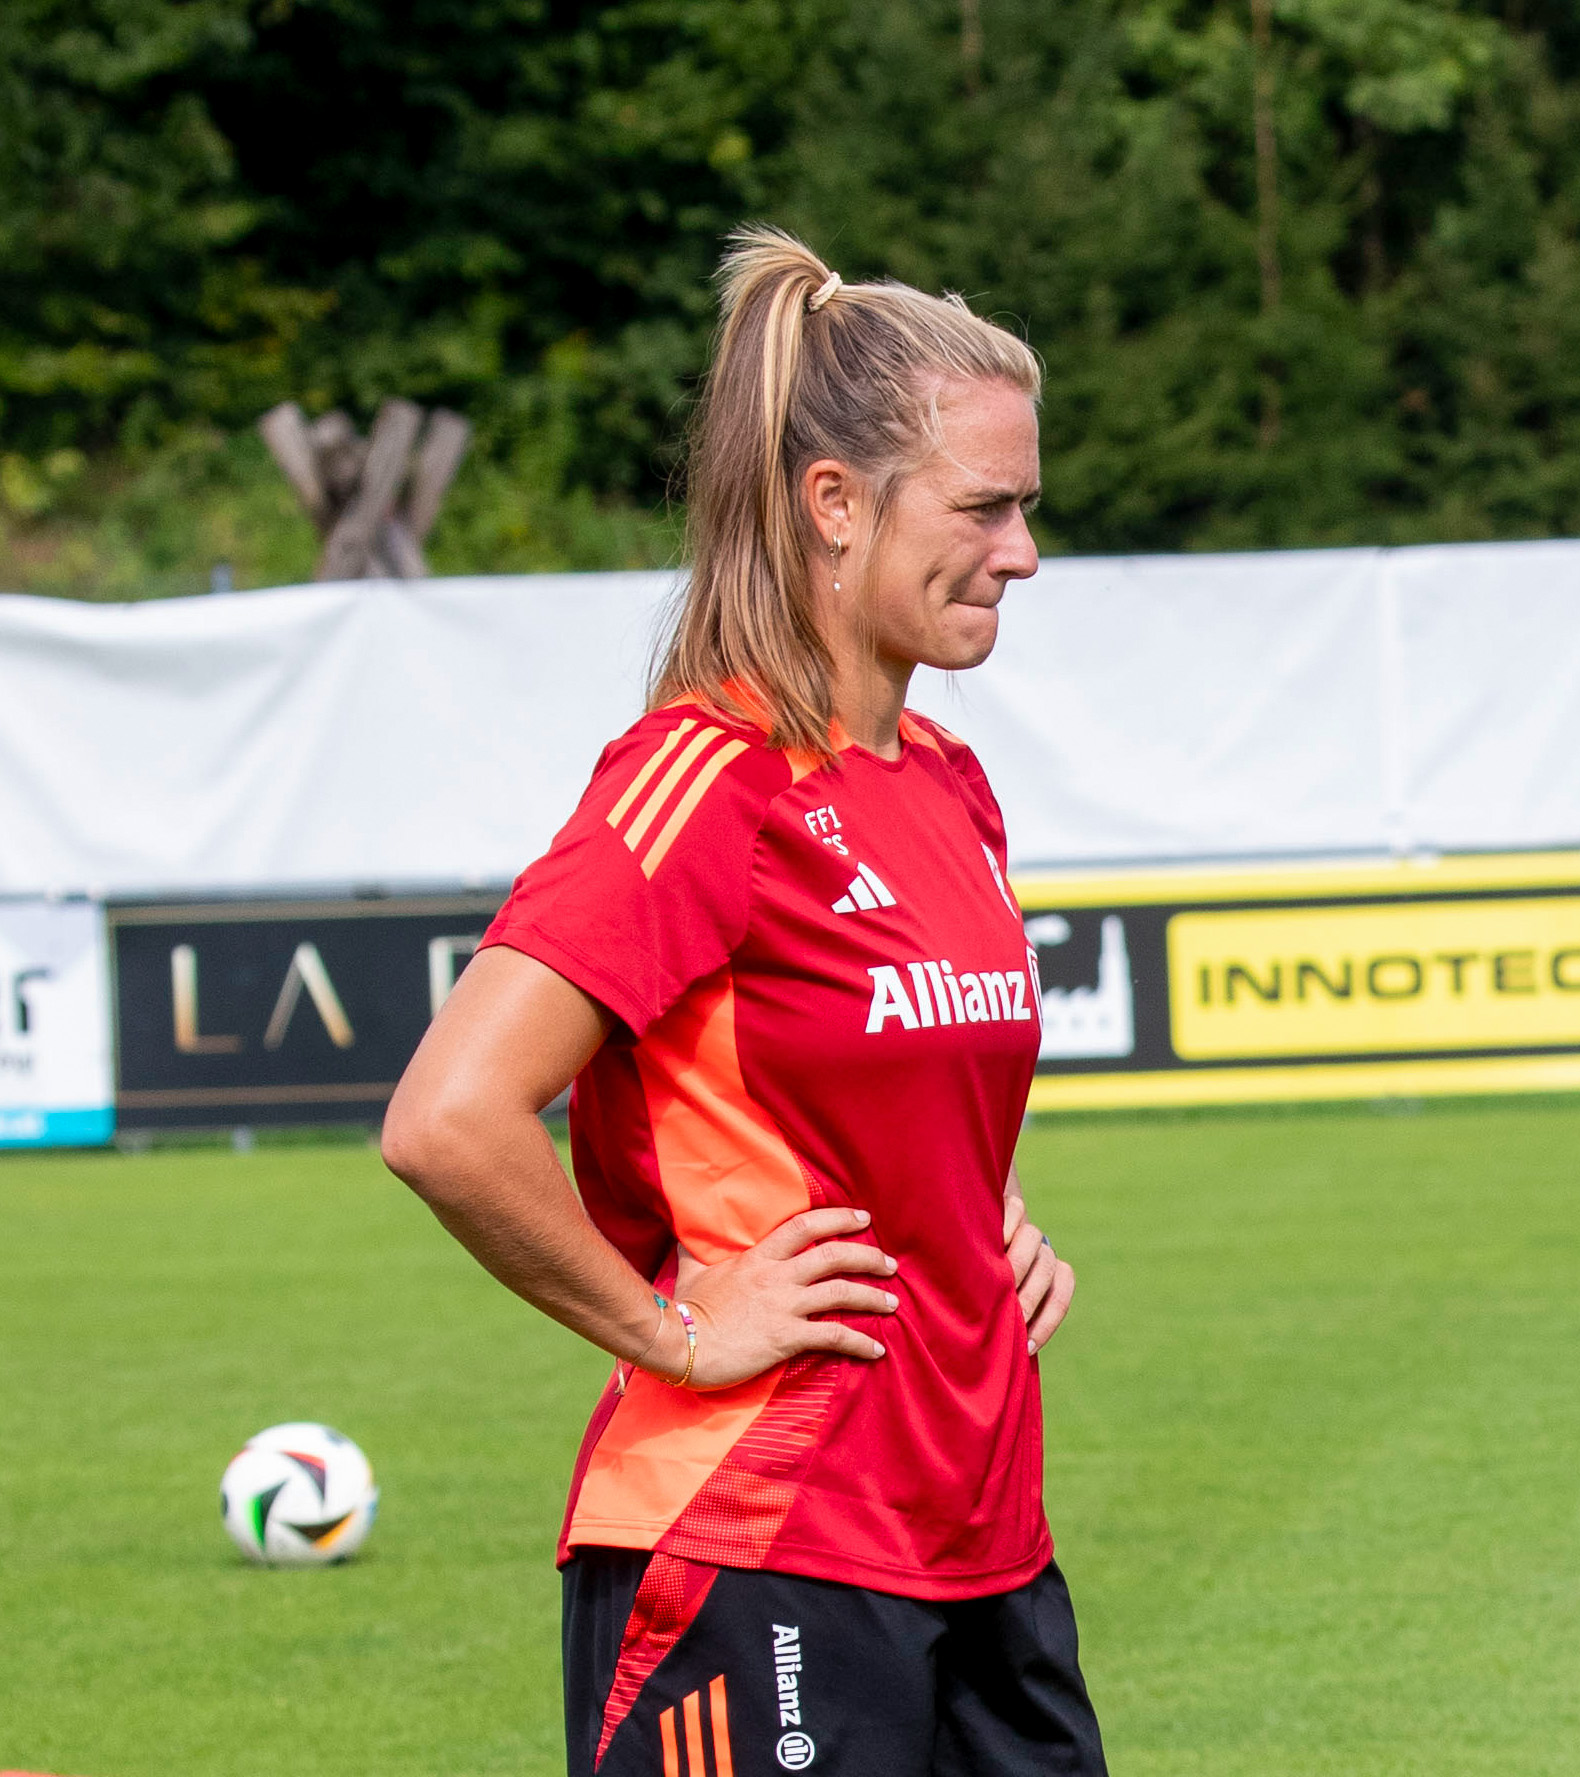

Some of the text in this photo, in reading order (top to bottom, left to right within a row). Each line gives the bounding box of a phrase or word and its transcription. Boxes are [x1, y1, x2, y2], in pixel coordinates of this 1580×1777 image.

[804, 804, 843, 836] FF1
[865, 958, 1031, 1034] Allianz
[771, 1623, 803, 1727] Allianz
